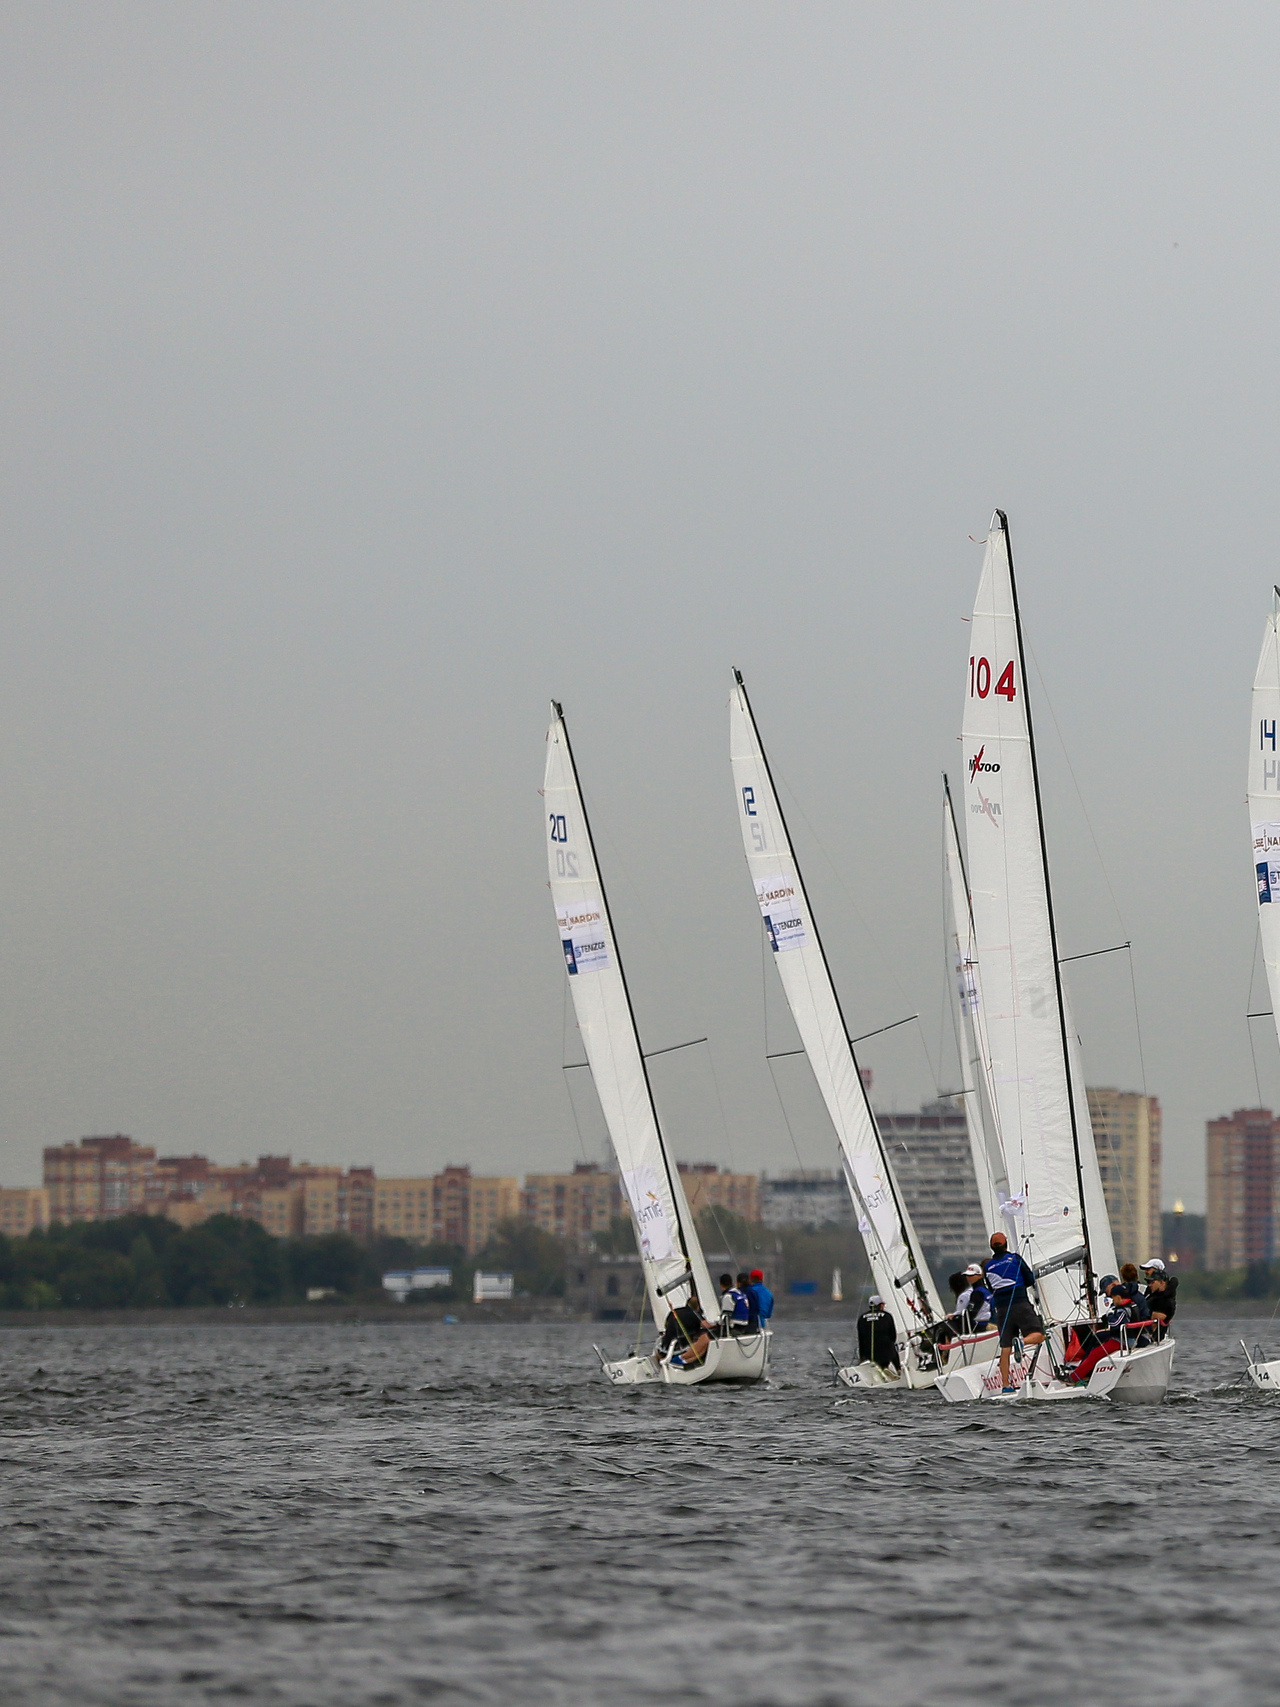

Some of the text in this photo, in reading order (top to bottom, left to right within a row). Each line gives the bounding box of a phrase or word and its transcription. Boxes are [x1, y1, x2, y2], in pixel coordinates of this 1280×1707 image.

[970, 656, 1016, 702] 104
[1260, 719, 1276, 752] 14
[550, 813, 568, 842] 20
[611, 1369, 624, 1380] 20
[849, 1373, 861, 1385] 12
[1257, 1371, 1270, 1382] 14
